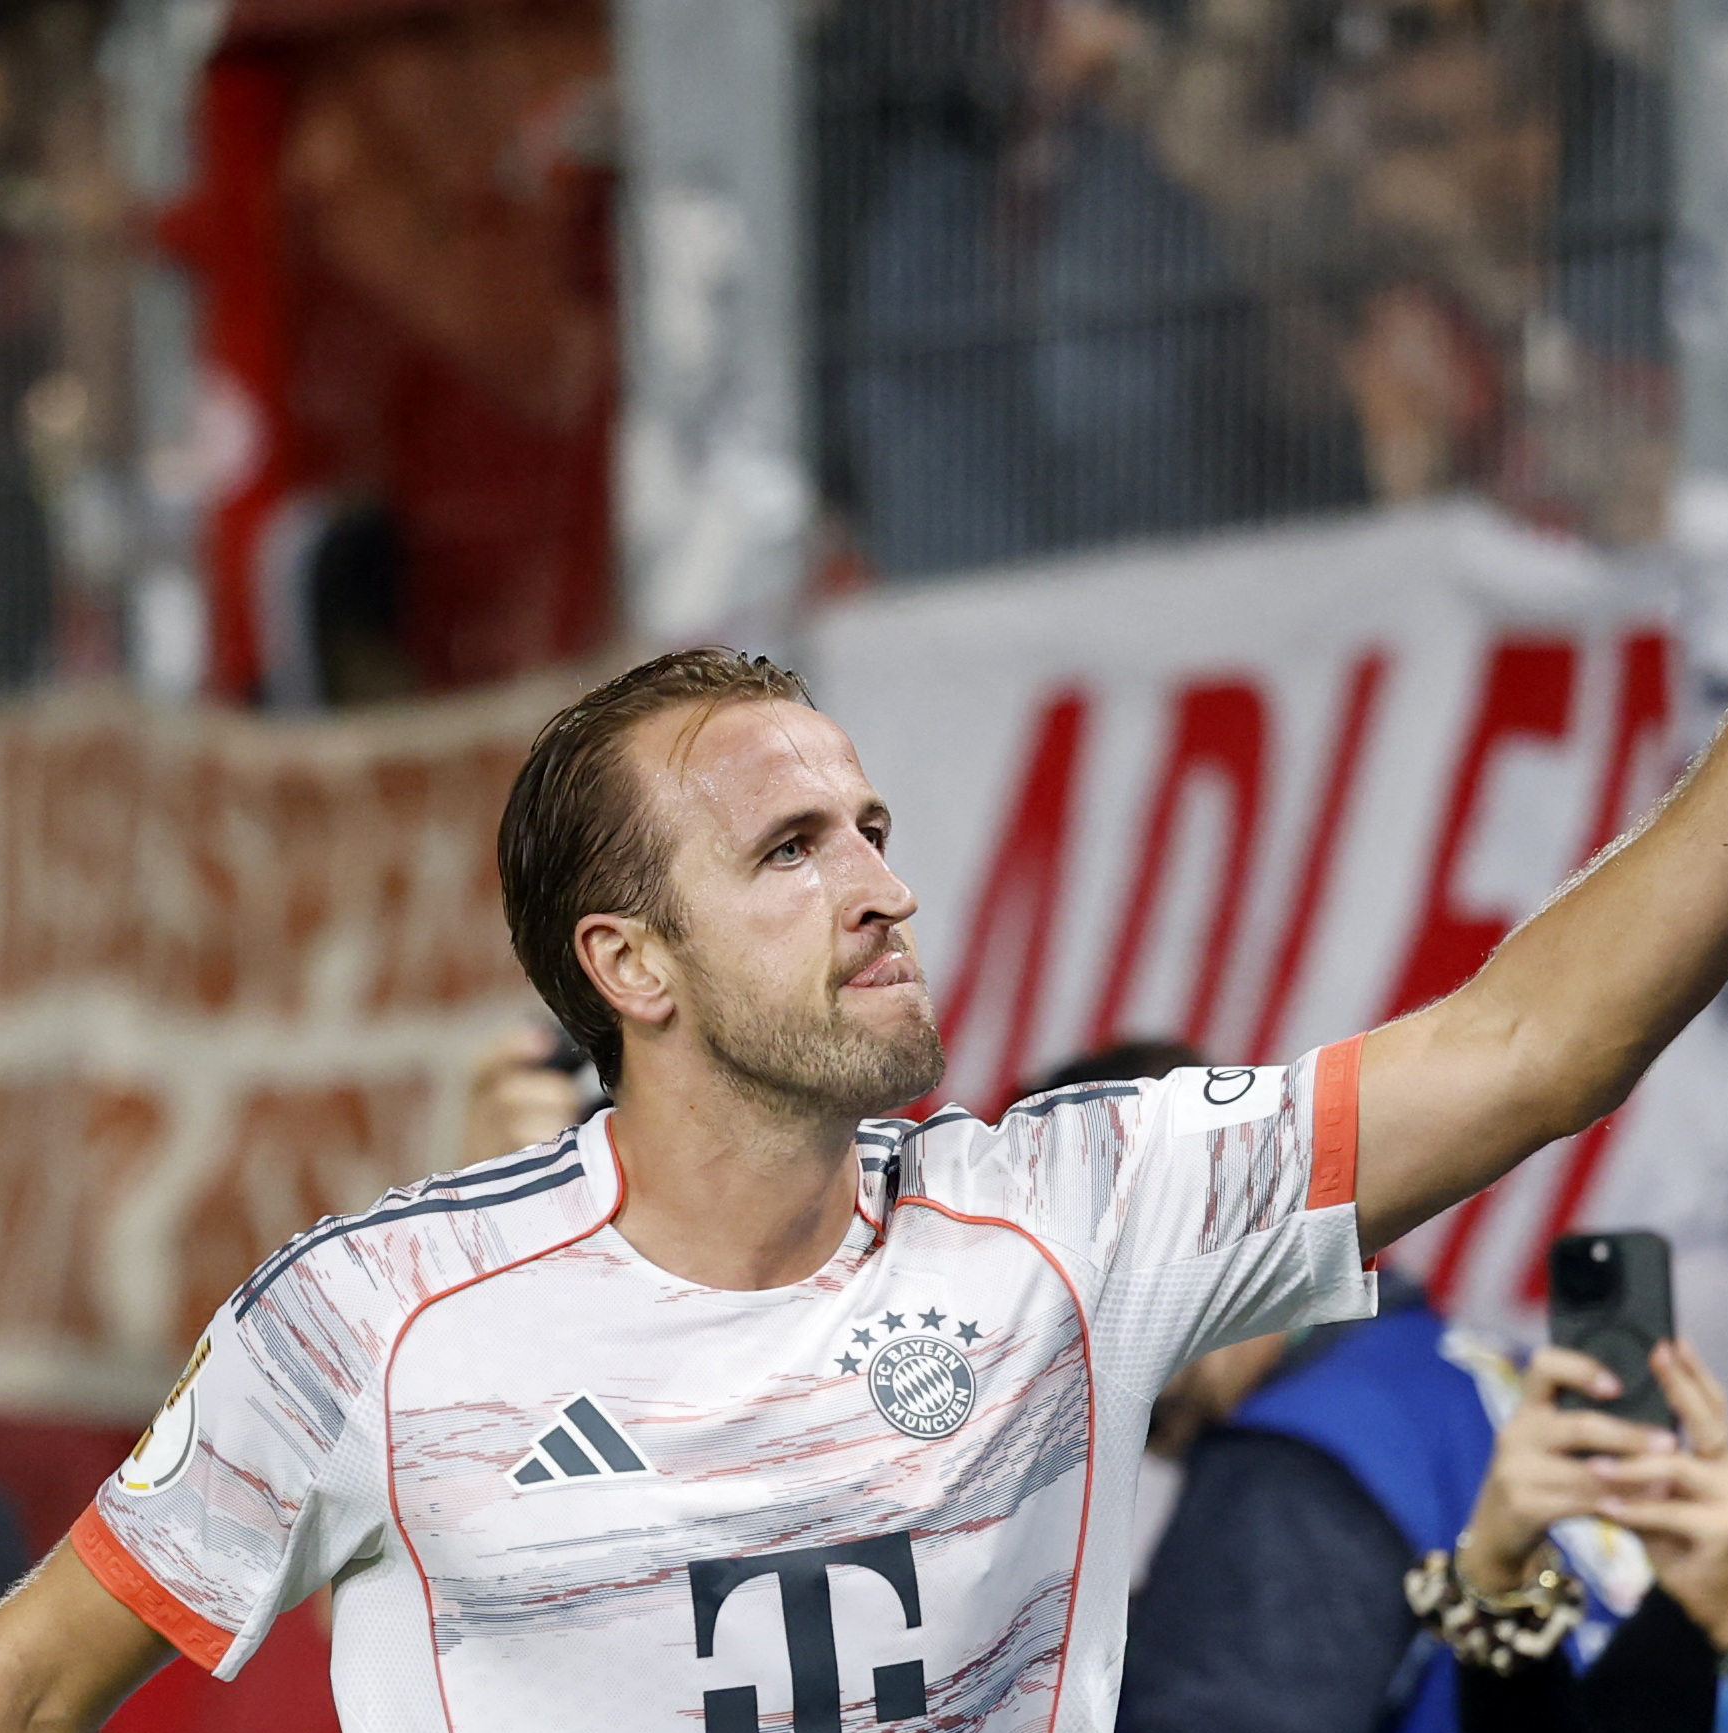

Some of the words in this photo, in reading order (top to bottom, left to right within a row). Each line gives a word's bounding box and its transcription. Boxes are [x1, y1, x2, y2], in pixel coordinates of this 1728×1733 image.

[877, 1363, 893, 1386] FC
[886, 1341, 961, 1371] BAYERN
[887, 1387, 970, 1432] MÜNCHEN
